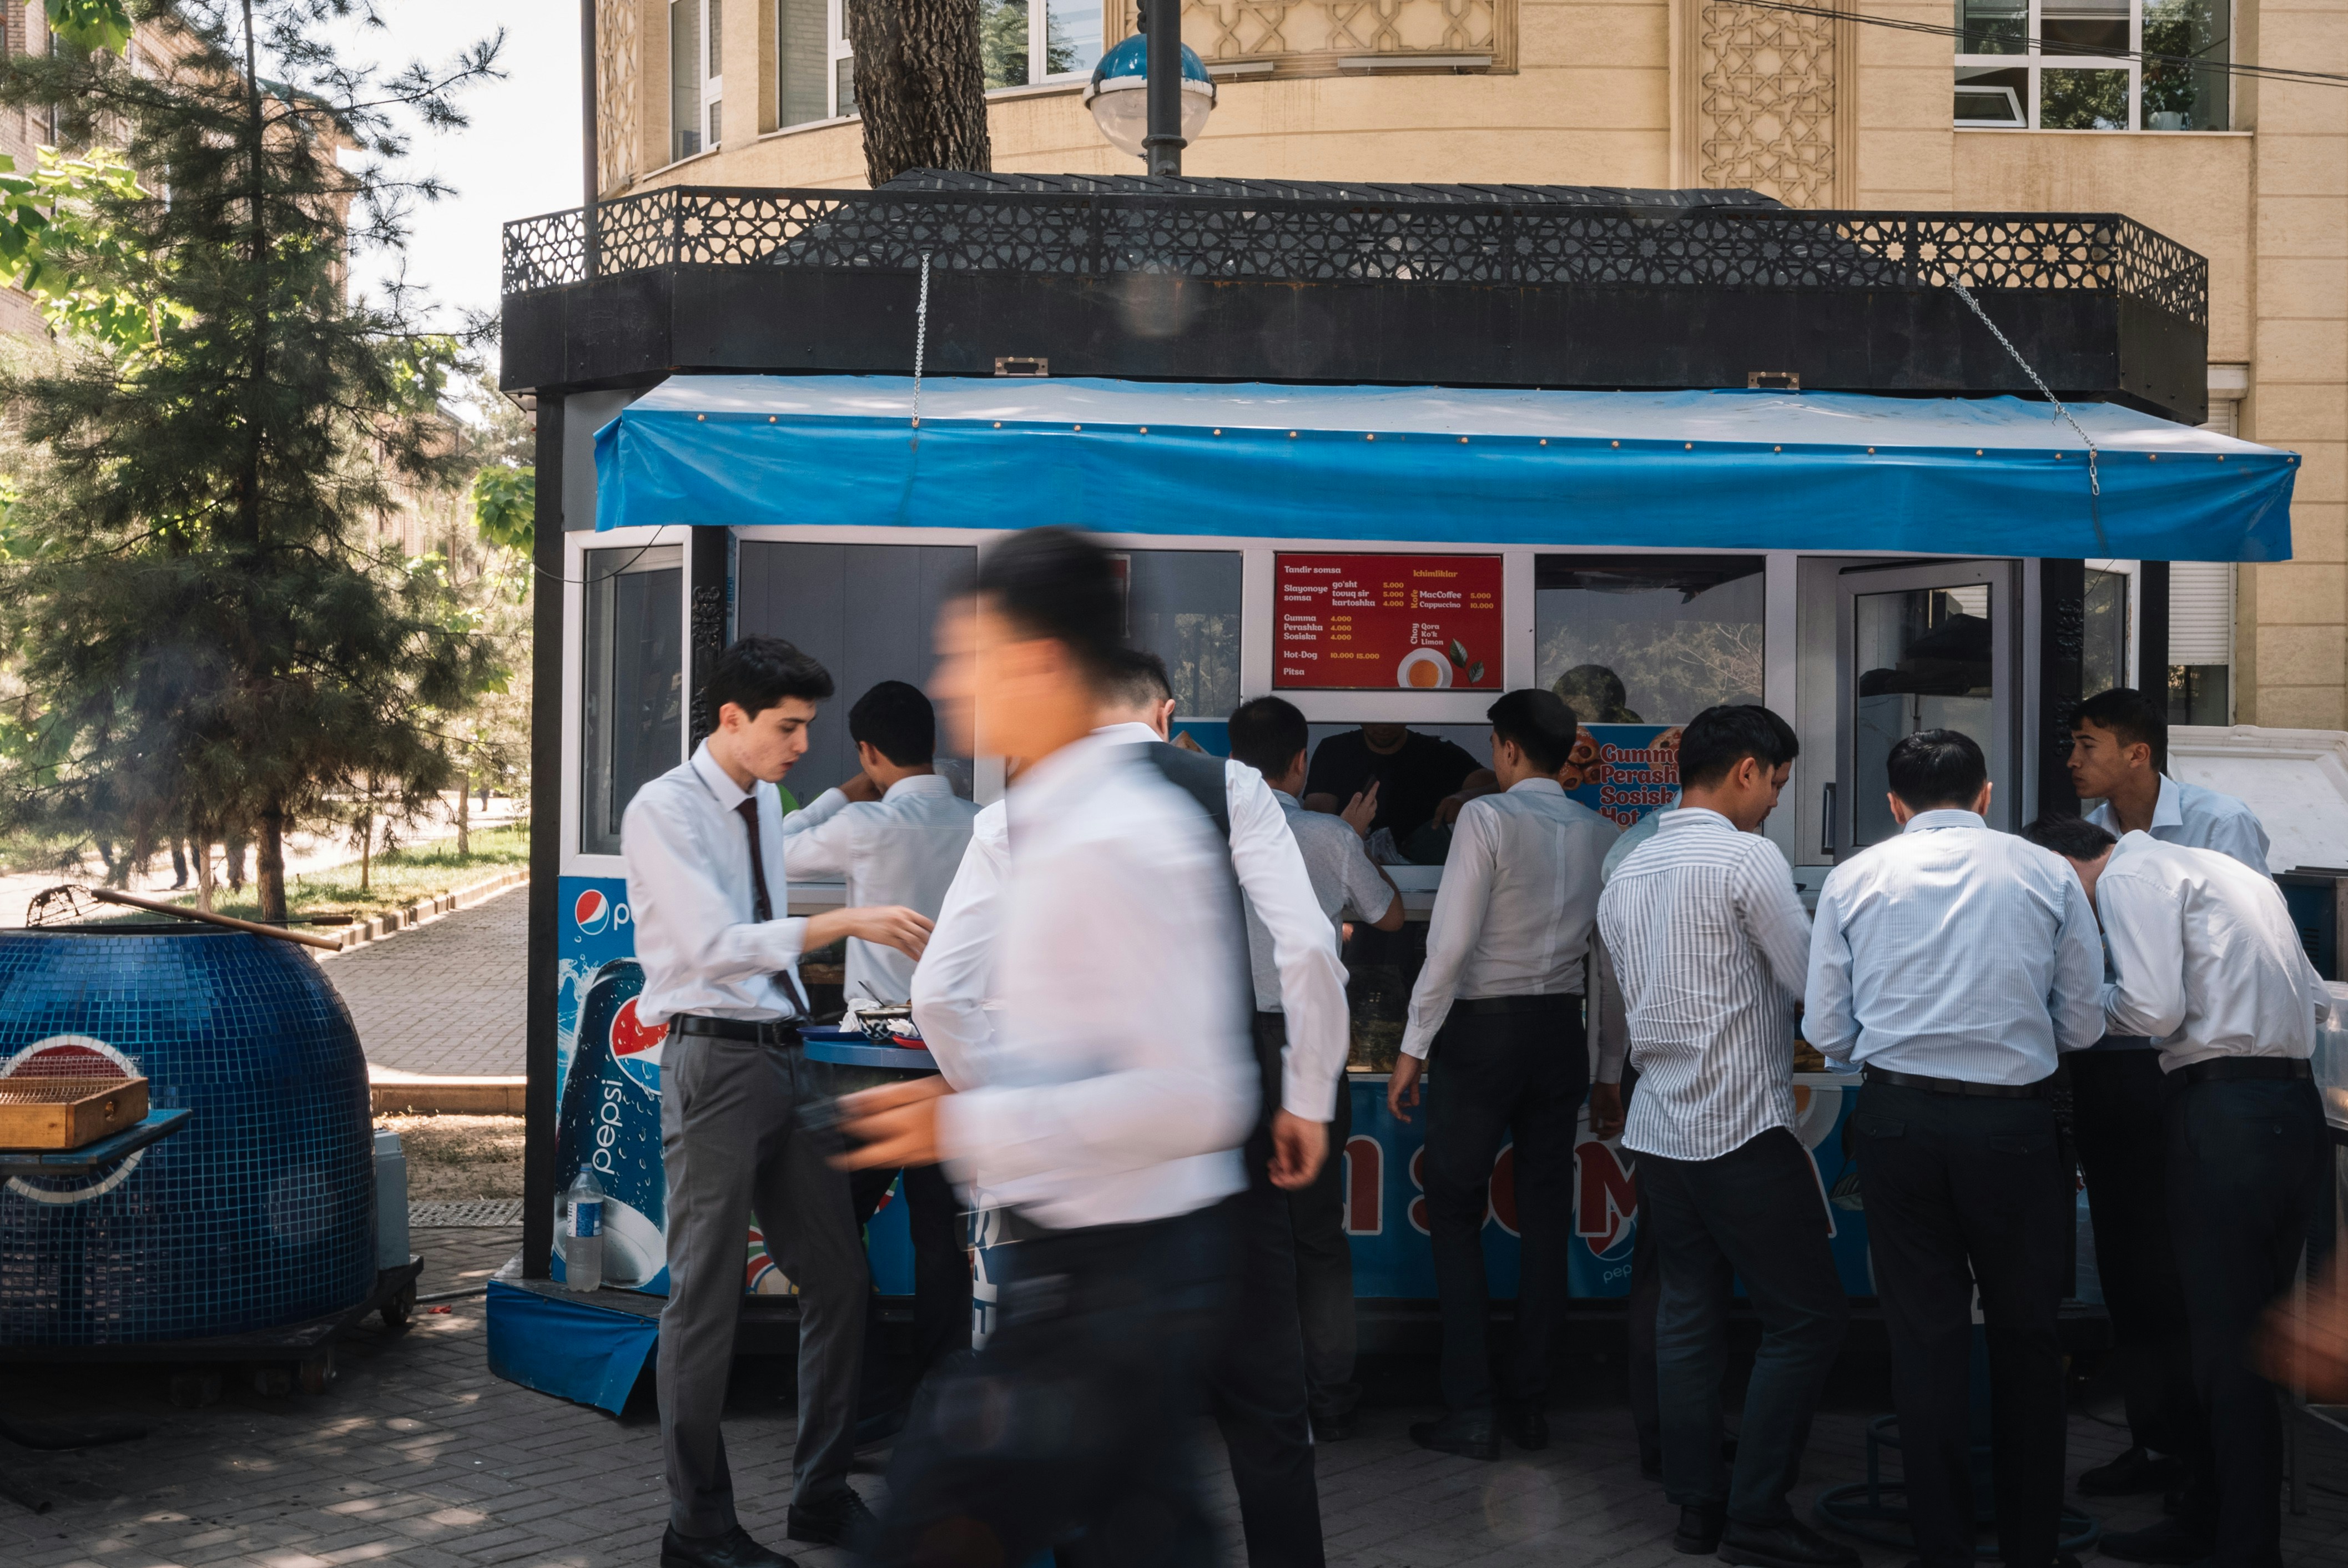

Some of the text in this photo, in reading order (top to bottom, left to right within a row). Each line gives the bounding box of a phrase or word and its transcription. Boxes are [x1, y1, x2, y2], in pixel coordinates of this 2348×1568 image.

[1284, 584, 1328, 593] Slayonoye
[1410, 623, 1419, 644] Choy
[1284, 651, 1317, 660] Hot-Dog
[1600, 764, 1680, 784] Perash
[1600, 785, 1677, 805] Sosisk
[1600, 806, 1640, 826] Hot
[592, 1079, 623, 1174] pepsi
[1603, 1264, 1632, 1284] pep
